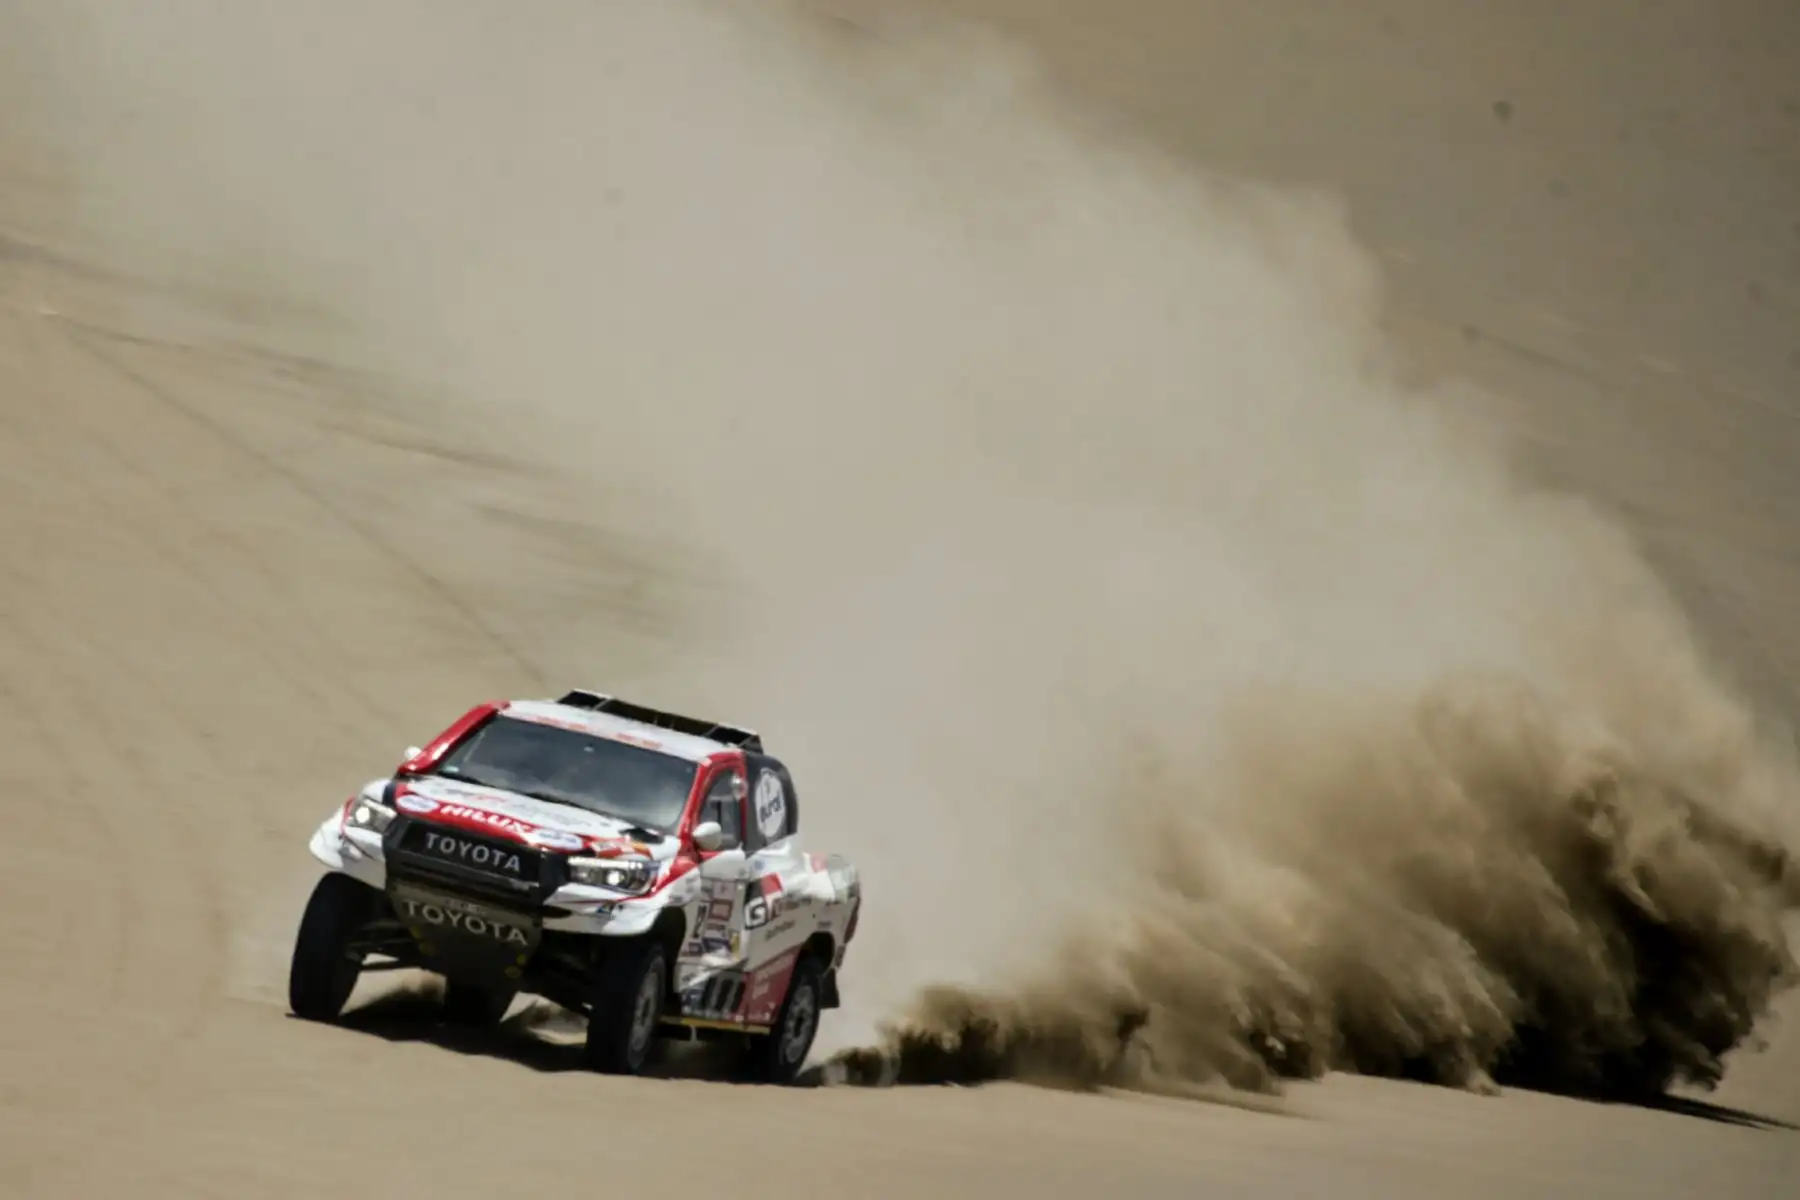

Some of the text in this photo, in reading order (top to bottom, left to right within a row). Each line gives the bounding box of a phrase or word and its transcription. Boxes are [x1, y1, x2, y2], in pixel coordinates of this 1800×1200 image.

[439, 804, 533, 836] HILUX
[425, 832, 521, 872] TOYOTA
[404, 900, 529, 946] TOYOTA
